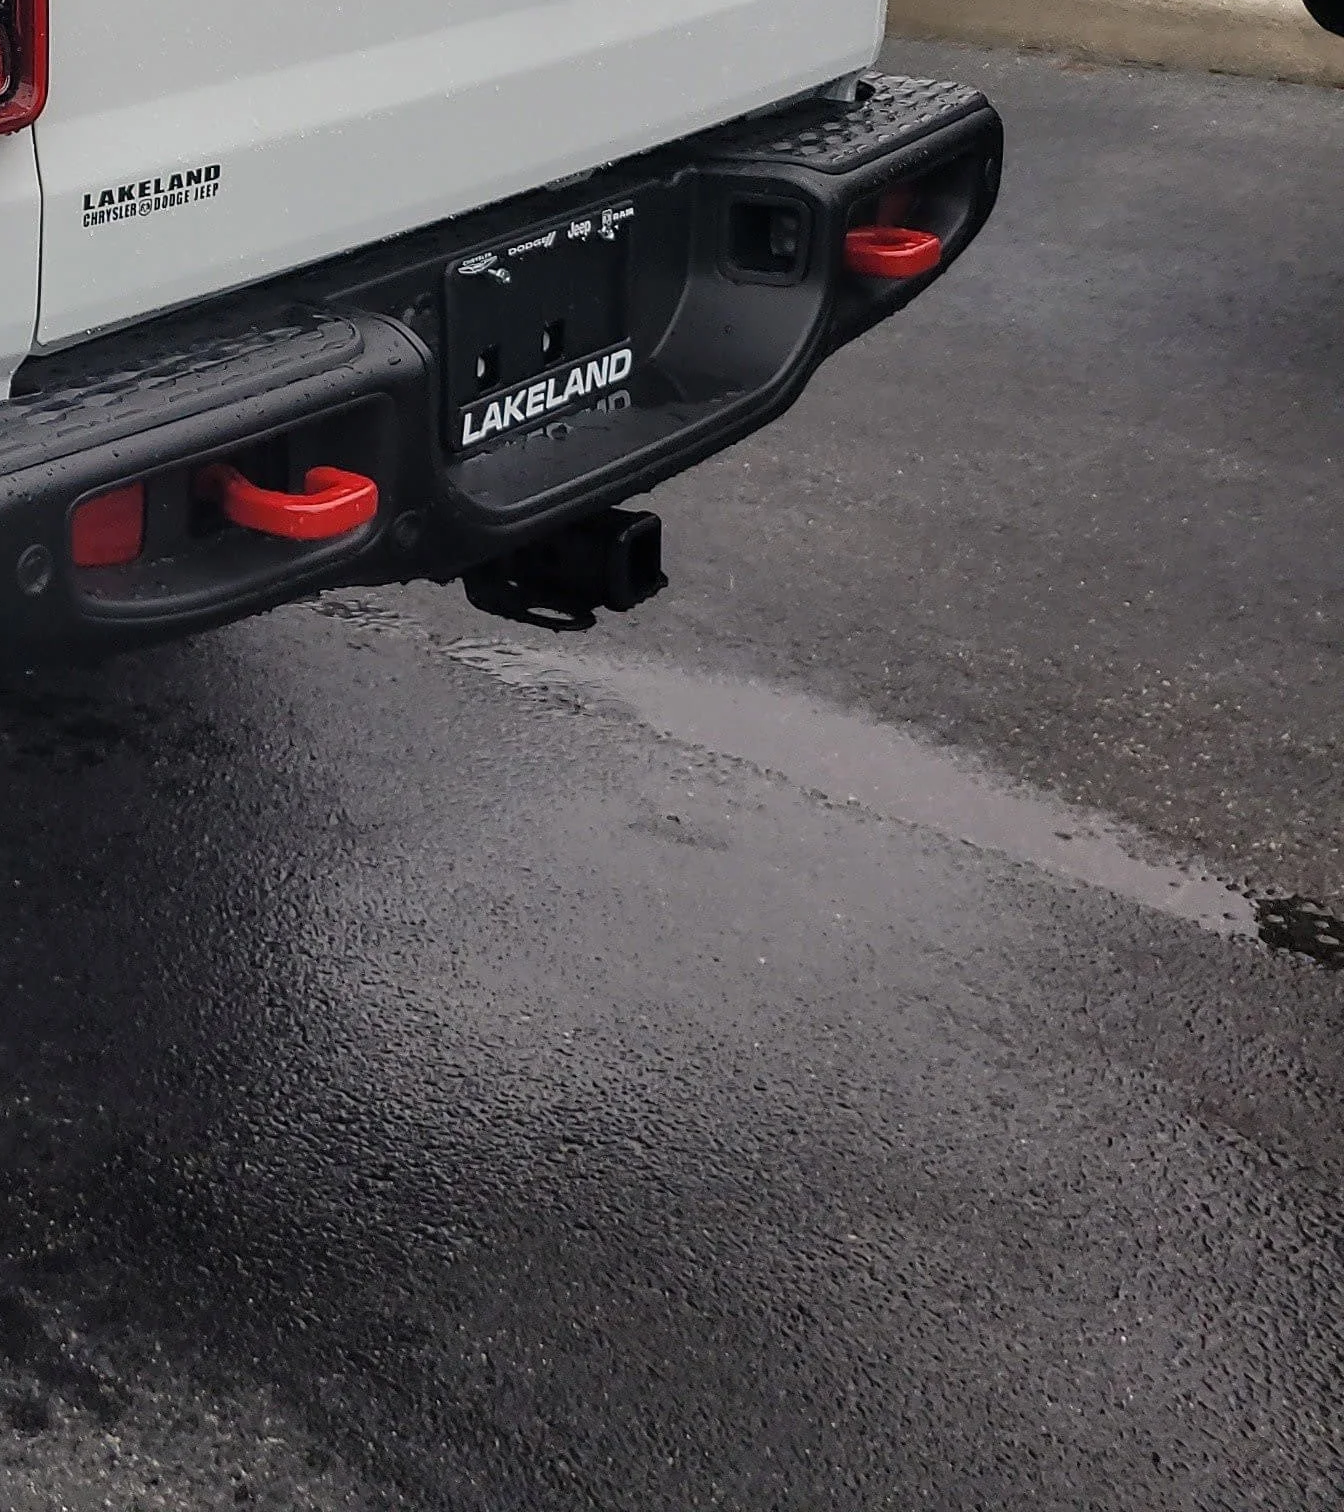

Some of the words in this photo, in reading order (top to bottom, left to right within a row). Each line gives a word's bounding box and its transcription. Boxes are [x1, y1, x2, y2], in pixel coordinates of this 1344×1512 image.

[83, 164, 221, 211] LAKELAND
[83, 202, 137, 228] CHRYSLER
[154, 190, 190, 211] DODGE
[194, 183, 219, 201] JEEP
[508, 234, 551, 256] DODGE
[567, 220, 591, 238] Jeep
[613, 207, 634, 221] RAM
[462, 348, 632, 445] LAKELAND
